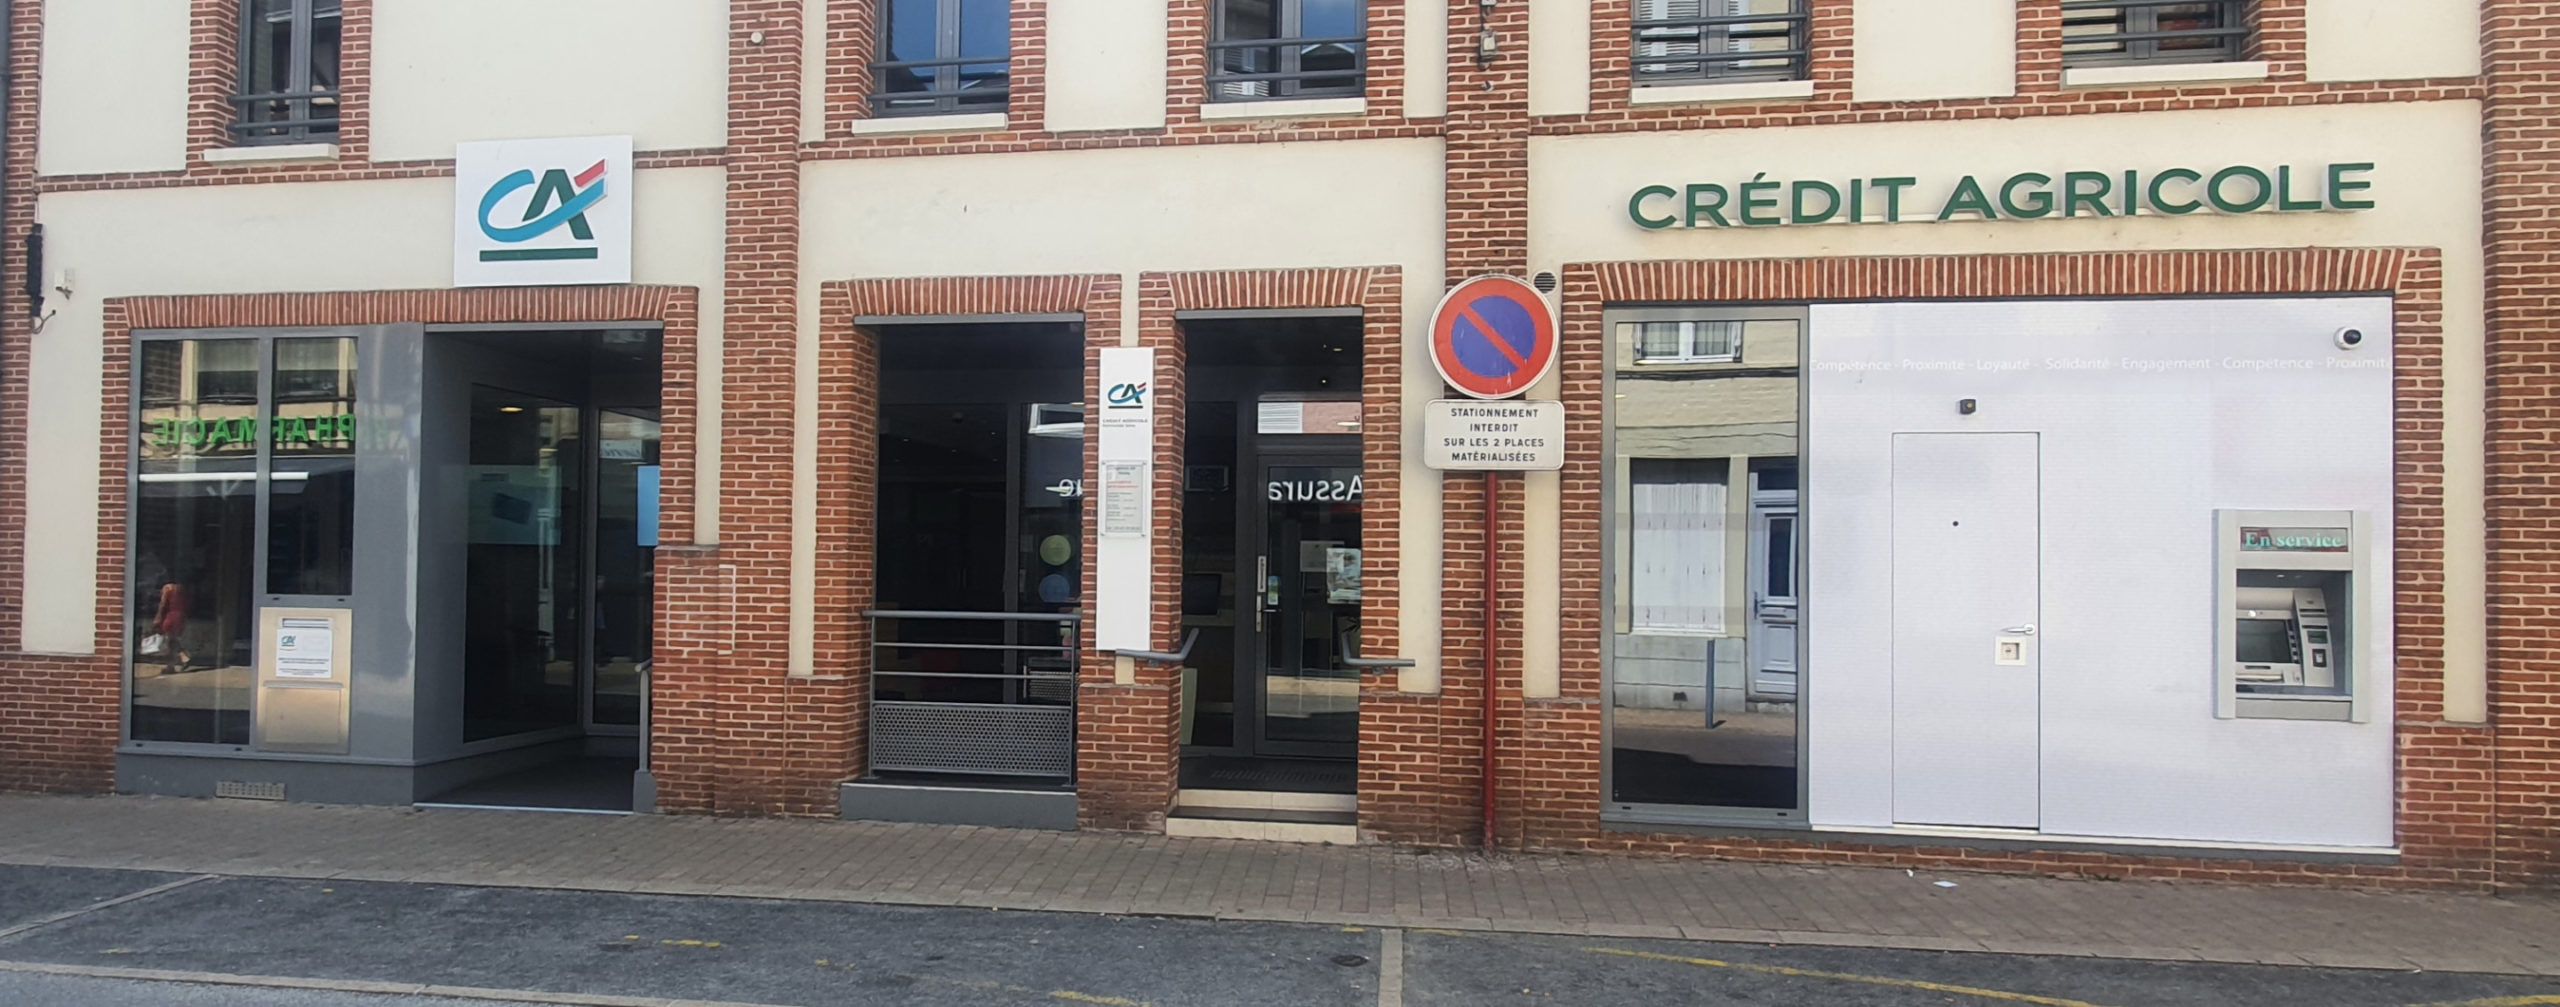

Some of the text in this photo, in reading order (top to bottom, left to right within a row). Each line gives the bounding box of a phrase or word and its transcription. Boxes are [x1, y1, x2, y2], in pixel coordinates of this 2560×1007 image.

[1627, 162, 2376, 230] CRÉDIT AGRICOLE
[2121, 358, 2210, 372] Engagement
[1450, 408, 1539, 418] STATIONNEMENT
[1469, 423, 1519, 432] INTERDIT
[1443, 438, 1544, 447] SUR LES 2 PLACES
[1451, 450, 1536, 462] MATÉRIALISÉES
[2244, 531, 2344, 548] En service
